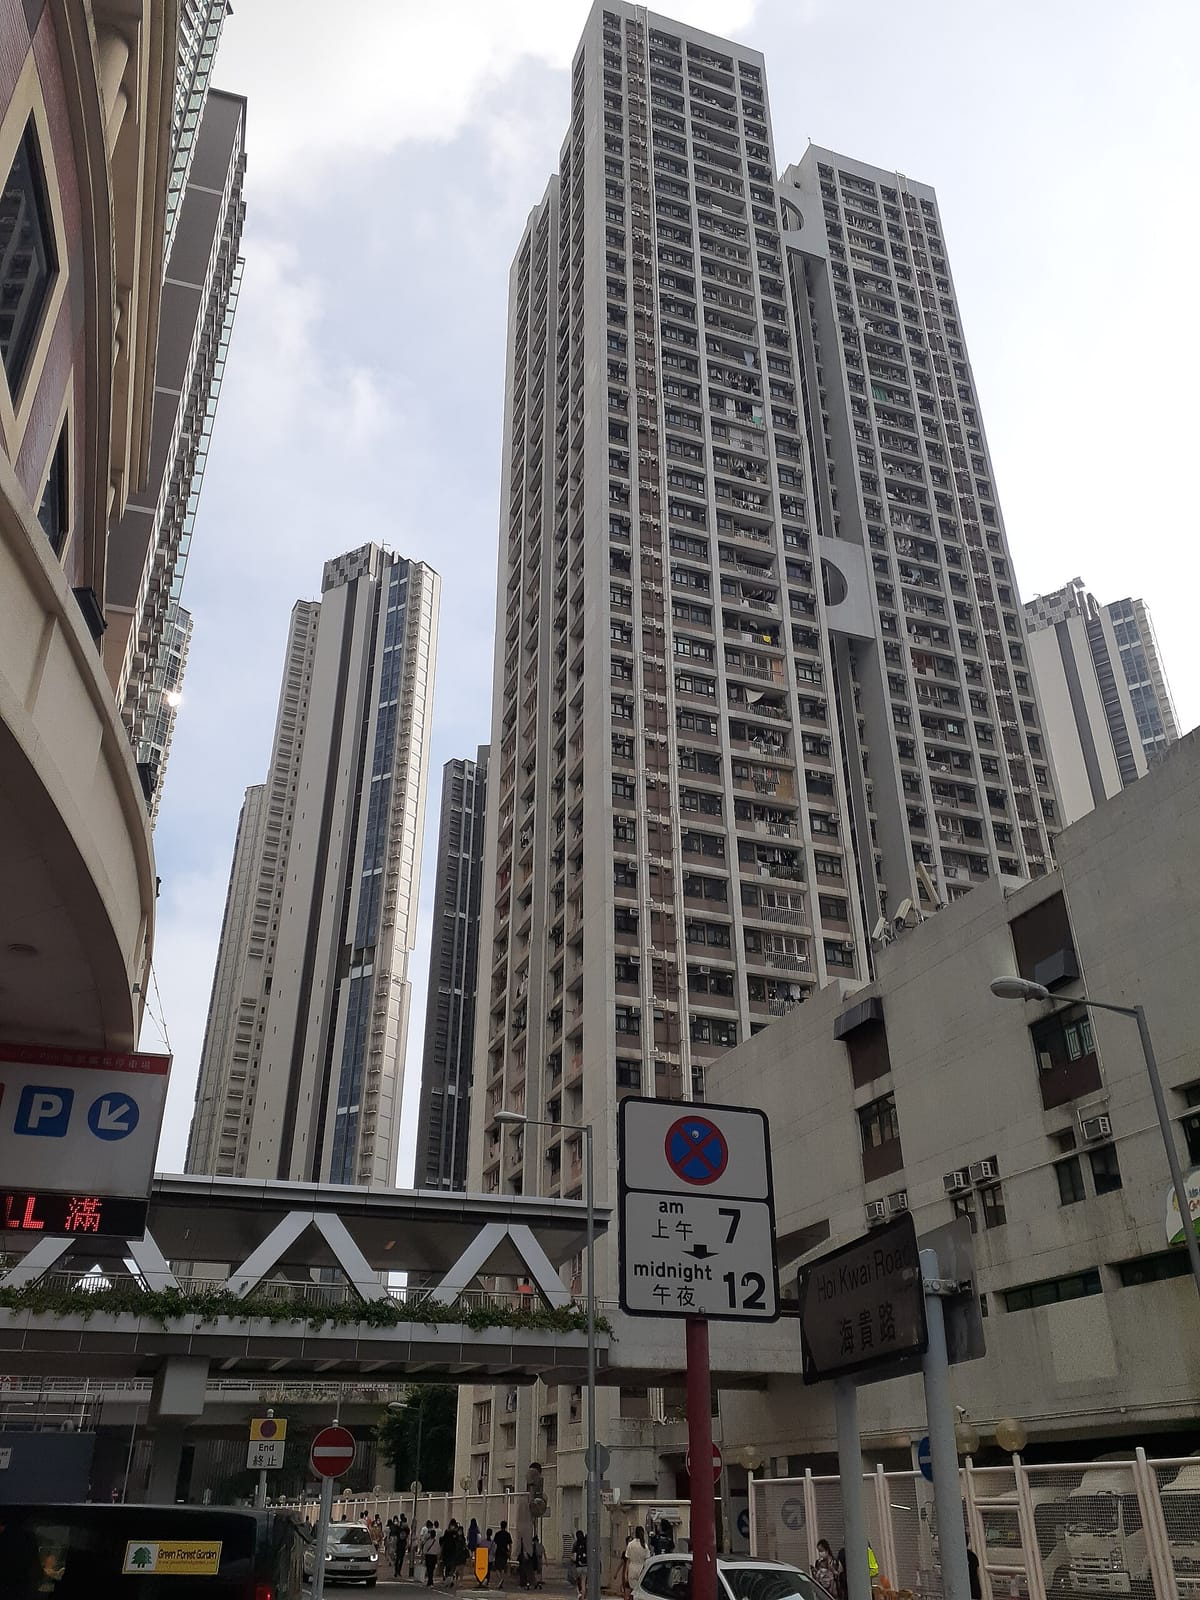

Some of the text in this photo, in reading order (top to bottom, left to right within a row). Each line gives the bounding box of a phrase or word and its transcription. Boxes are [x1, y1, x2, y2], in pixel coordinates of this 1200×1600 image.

[27, 1093, 63, 1130] P
[64, 1197, 103, 1232] 滿
[658, 1200, 684, 1215] am
[651, 1219, 694, 1242] 上午
[718, 1207, 741, 1244] 7
[633, 1261, 713, 1283] midnight
[816, 1273, 838, 1304] Hoi
[839, 1257, 873, 1296] Kwai
[652, 1284, 696, 1308] 午夜
[722, 1271, 767, 1311] 12
[839, 1300, 897, 1356] 海貴路
[258, 1443, 275, 1453] End
[252, 1455, 278, 1467] 終止
[157, 1548, 217, 1561] Green Forest Garden
